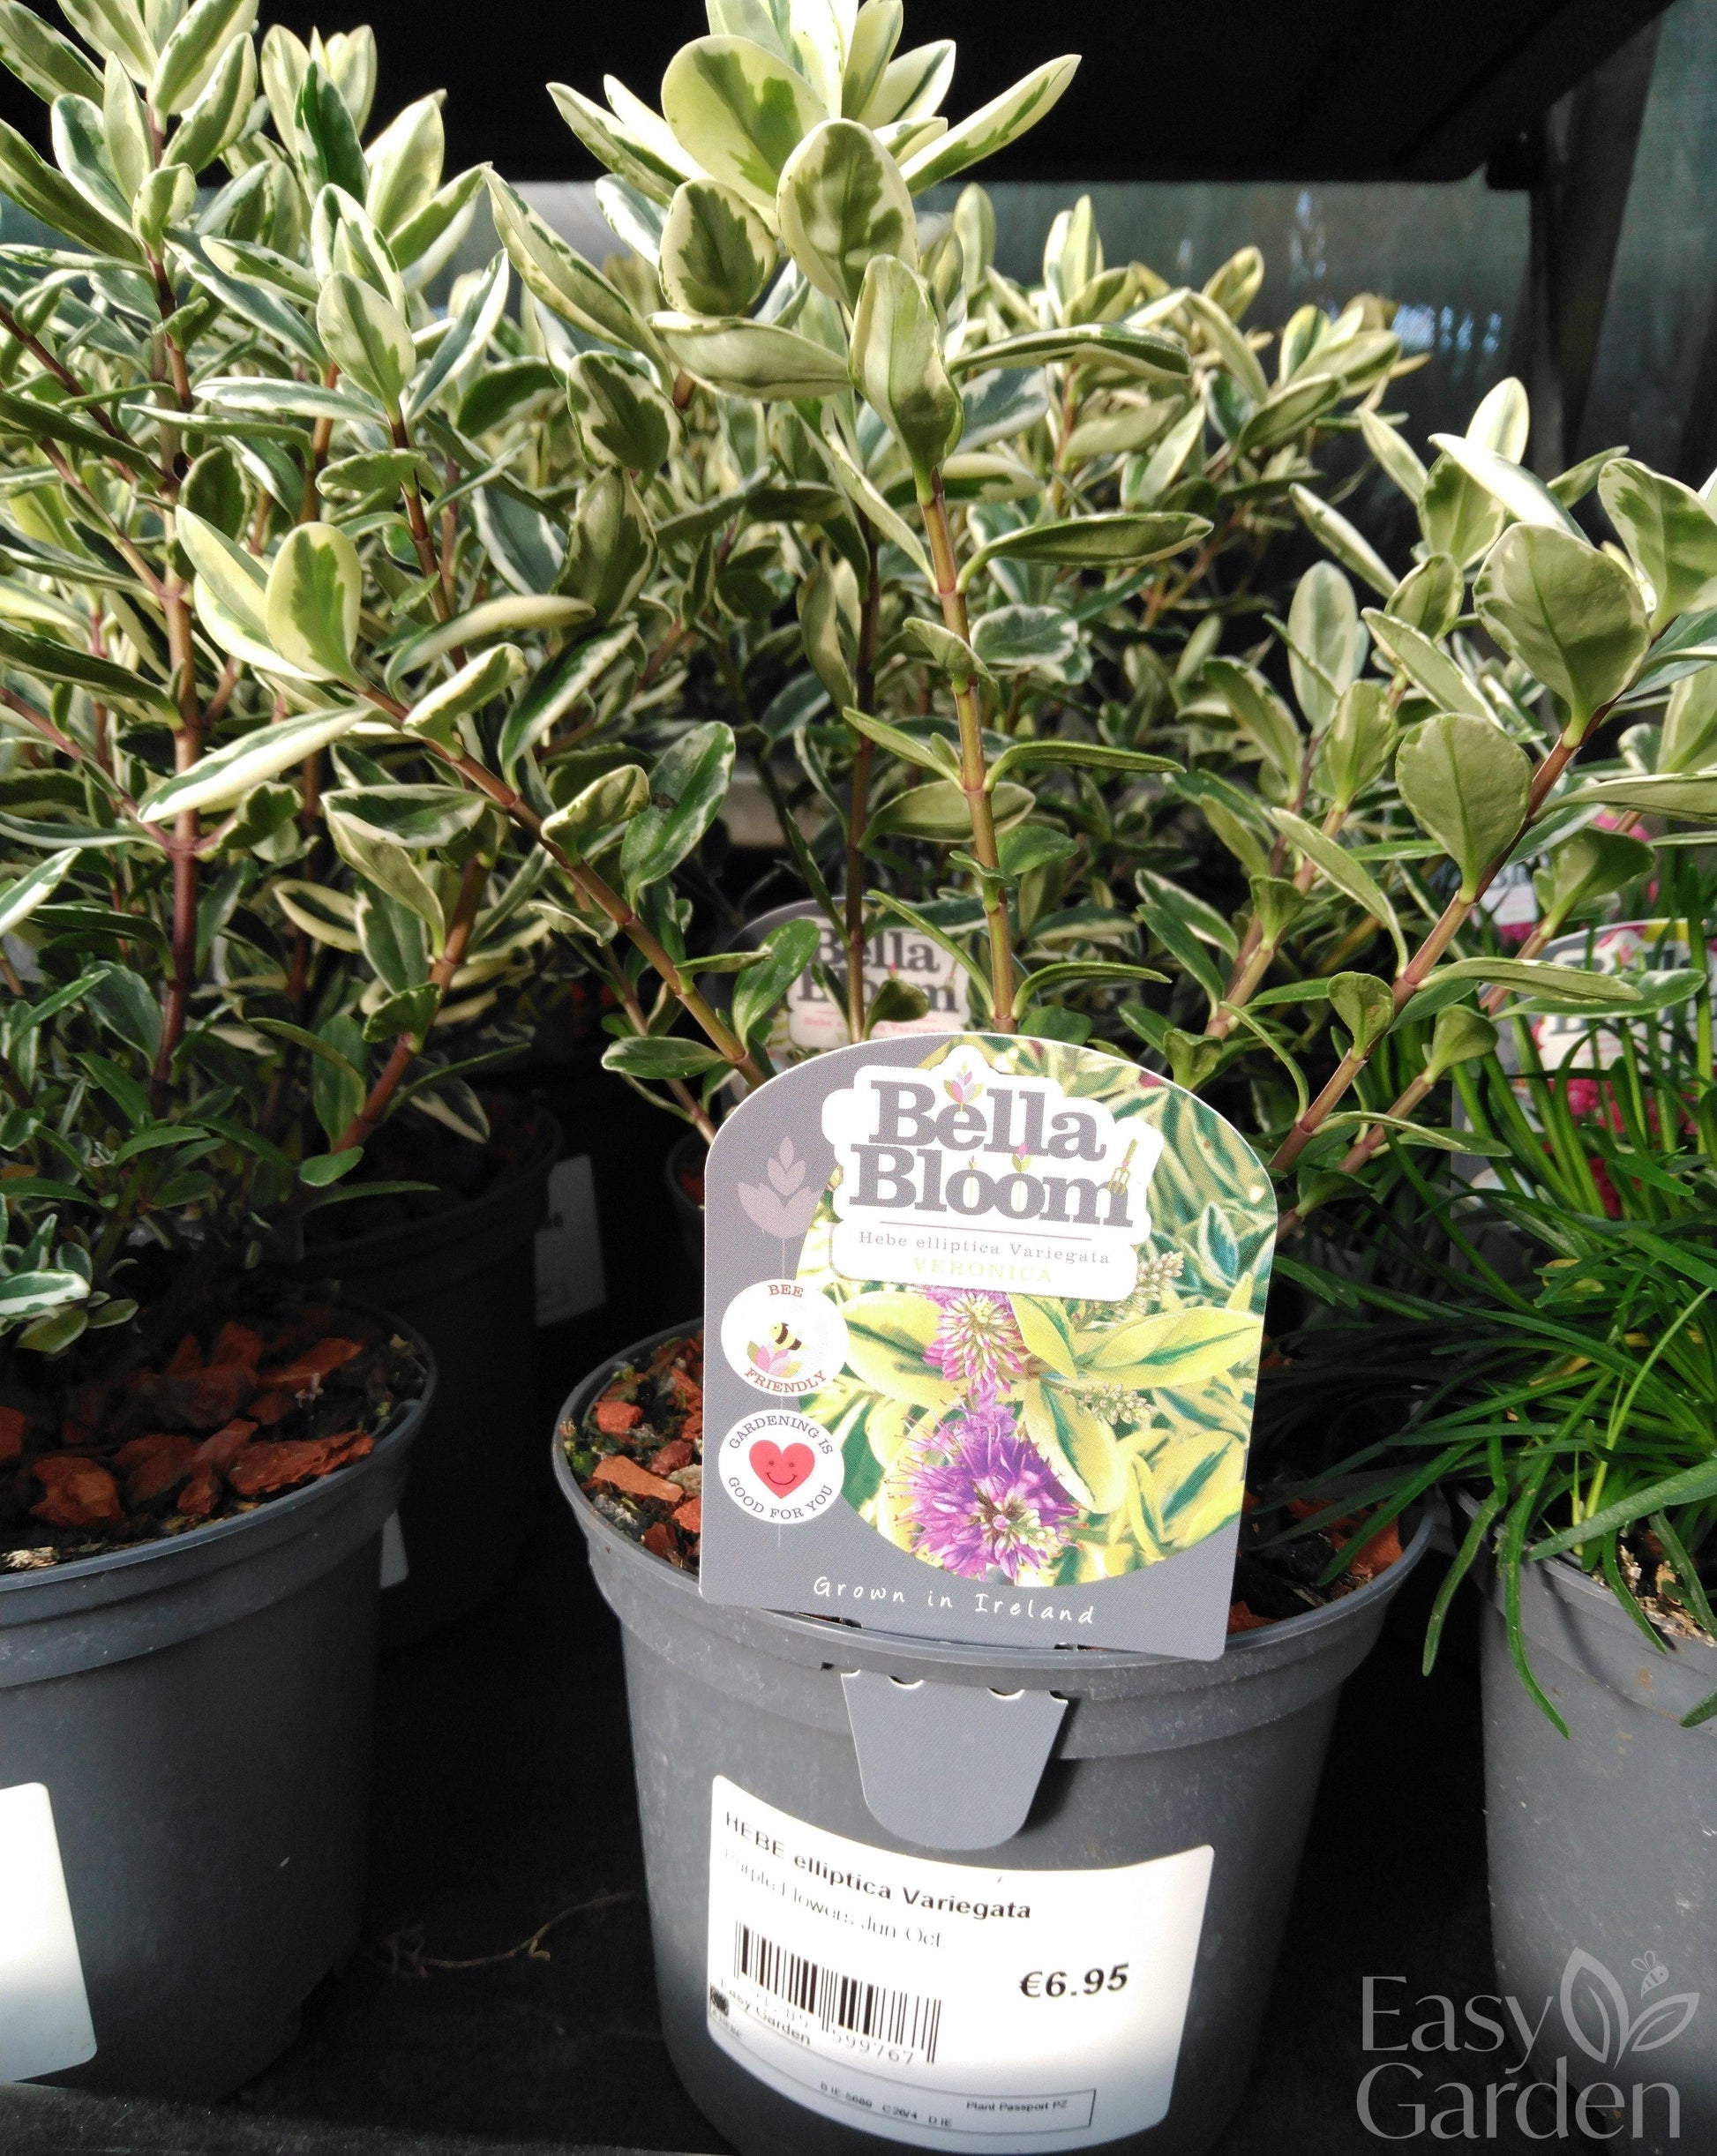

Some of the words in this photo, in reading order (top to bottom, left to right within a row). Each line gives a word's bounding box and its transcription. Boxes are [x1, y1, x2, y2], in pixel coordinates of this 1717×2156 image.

[868, 1079, 1106, 1163] Bella
[849, 1144, 1133, 1228] Bloom
[859, 1231, 907, 1246] Hebe
[916, 1237, 1000, 1254] elliptica
[1009, 1244, 1110, 1264] Variegata
[913, 1258, 1052, 1284] VERONICA
[768, 1284, 804, 1298] BEE
[744, 1368, 827, 1394] FRIENDLY
[729, 1415, 819, 1449] GARDENING
[819, 1437, 834, 1455] IS
[728, 1477, 765, 1513] GOOD
[769, 1507, 804, 1519] FOR
[806, 1485, 833, 1511] YOU
[814, 1576, 905, 1603] Grown
[927, 1591, 953, 1608] in
[974, 1593, 1095, 1625] Ireland
[726, 1811, 785, 1860] HEBE
[794, 1854, 891, 1899] elliptica
[903, 1886, 1031, 1920] Variegata
[1018, 1962, 1129, 1998] €6.95
[756, 2007, 811, 2045] Garden
[966, 2101, 995, 2111] Plant
[1000, 2101, 1048, 2112] Passport
